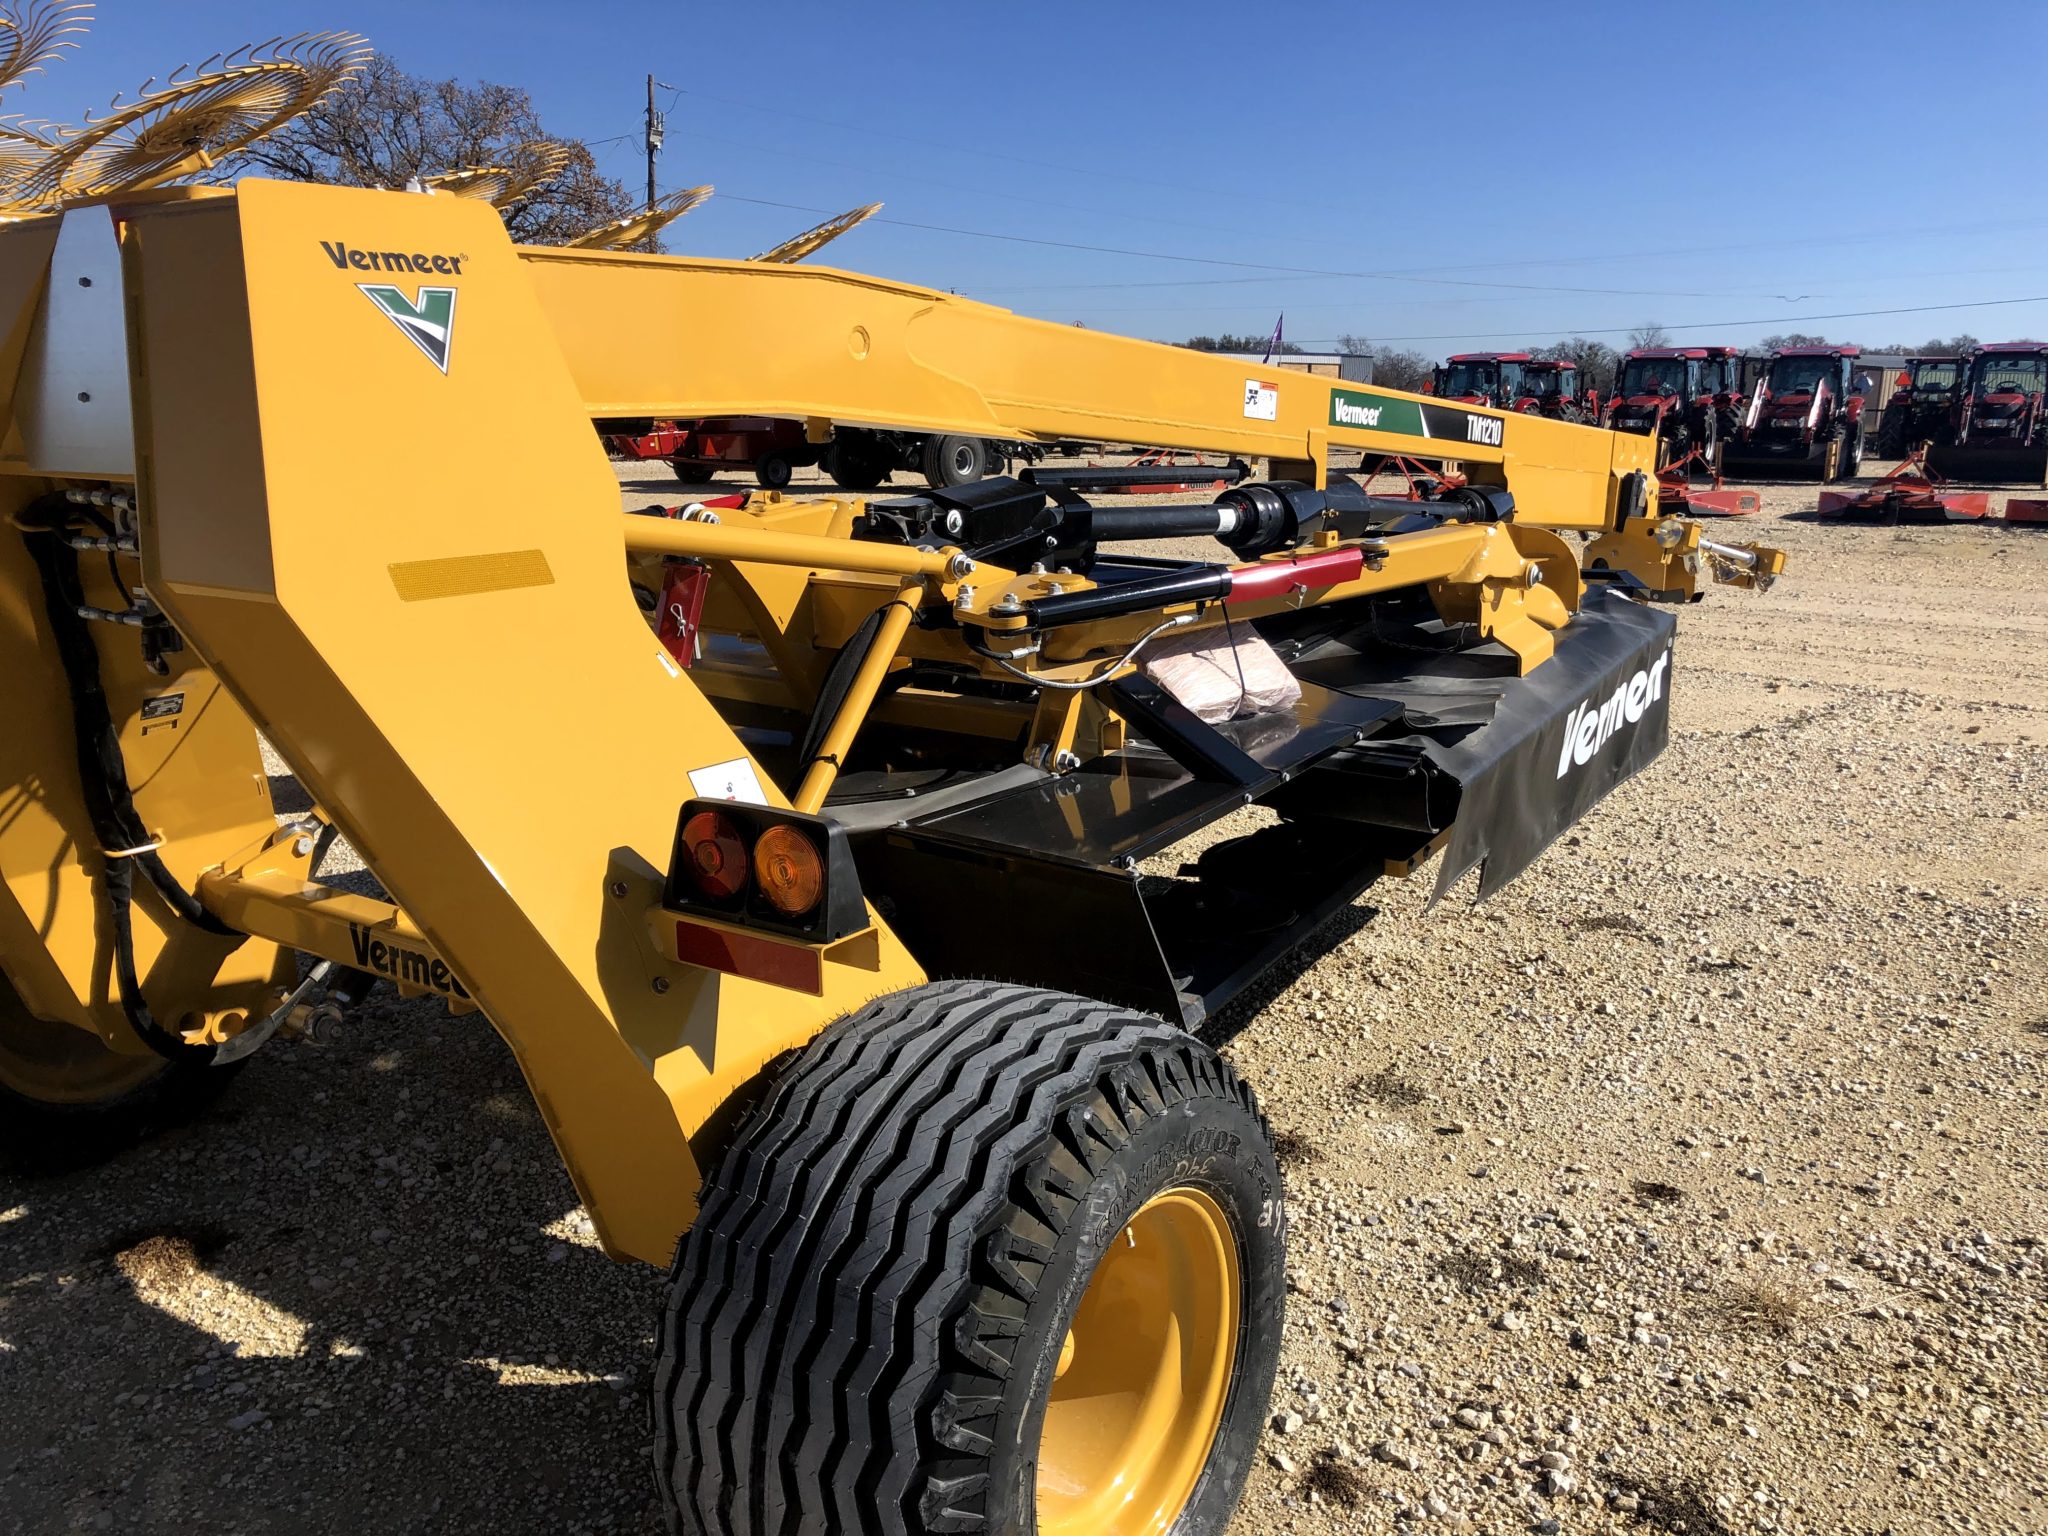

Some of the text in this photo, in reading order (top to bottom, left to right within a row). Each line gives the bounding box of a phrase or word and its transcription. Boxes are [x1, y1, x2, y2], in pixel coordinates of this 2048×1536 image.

[319, 240, 463, 275] Vermeer
[1335, 397, 1382, 426] Vermeer
[1467, 414, 1502, 445] TM1210
[349, 921, 471, 999] Verme
